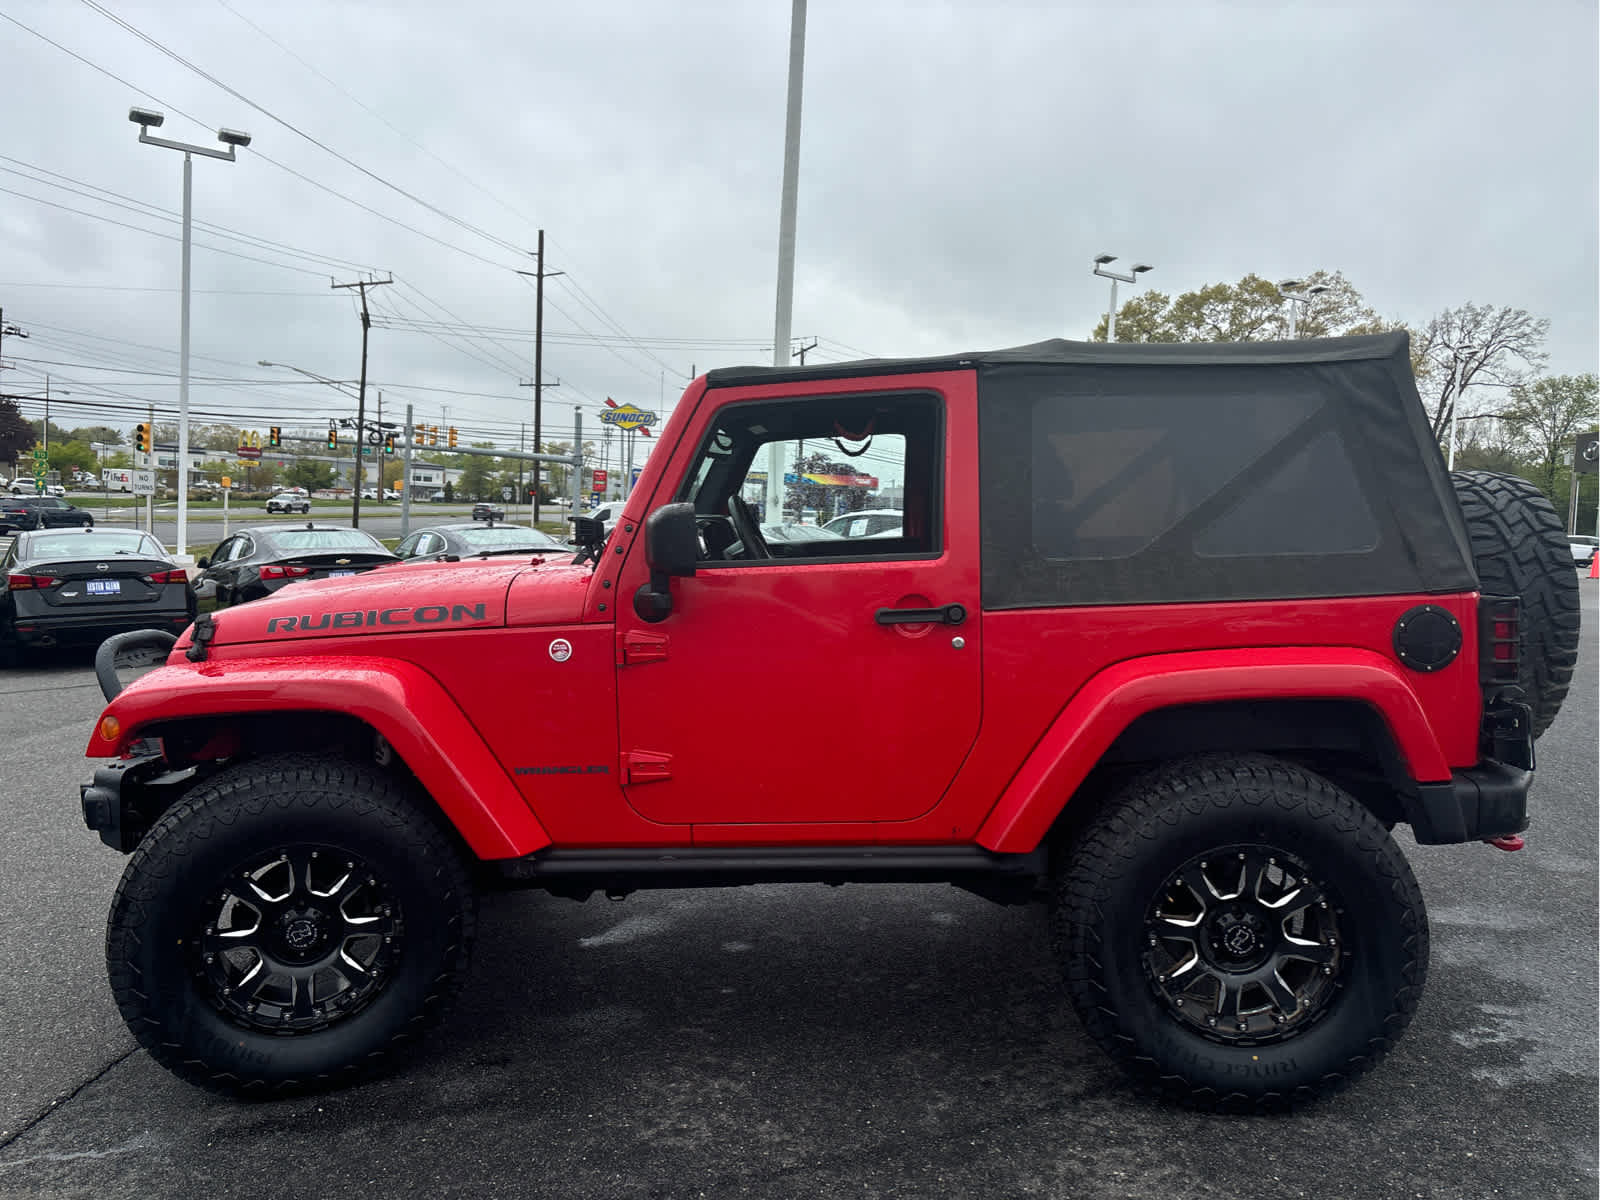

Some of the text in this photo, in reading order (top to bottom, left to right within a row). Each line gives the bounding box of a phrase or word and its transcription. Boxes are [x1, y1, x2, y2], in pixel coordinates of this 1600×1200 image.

[604, 411, 652, 423] SUNOCO
[134, 483, 154, 491] TURNS
[267, 603, 486, 633] RUBICON
[514, 765, 609, 775] WRANGLER
